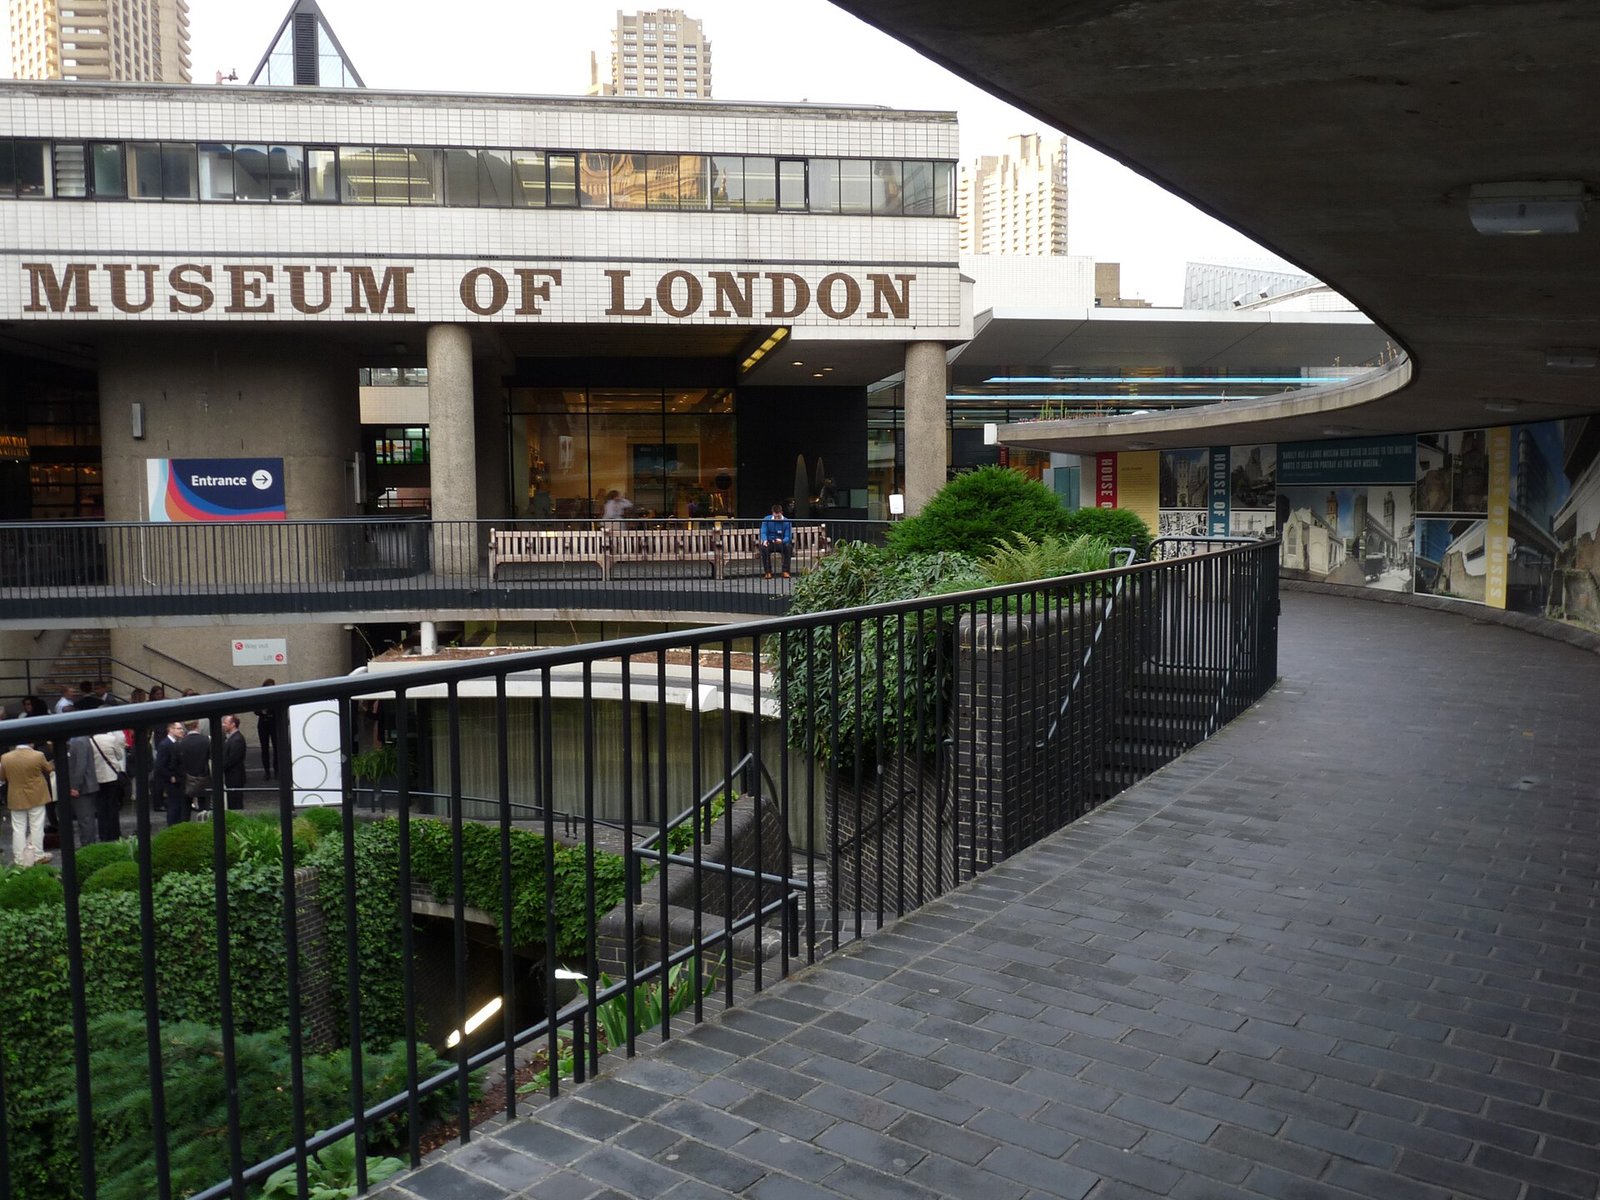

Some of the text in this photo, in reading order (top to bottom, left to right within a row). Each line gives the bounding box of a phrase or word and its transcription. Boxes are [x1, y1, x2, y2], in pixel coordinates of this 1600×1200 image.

[22, 262, 917, 320] MUSEUM OF LONDON
[191, 474, 247, 488] Entrance
[1101, 458, 1113, 496] HOUSE
[1213, 453, 1226, 496] HOUSE
[1213, 501, 1226, 517] OF
[1490, 436, 1506, 599] HOUSE OF MUSES
